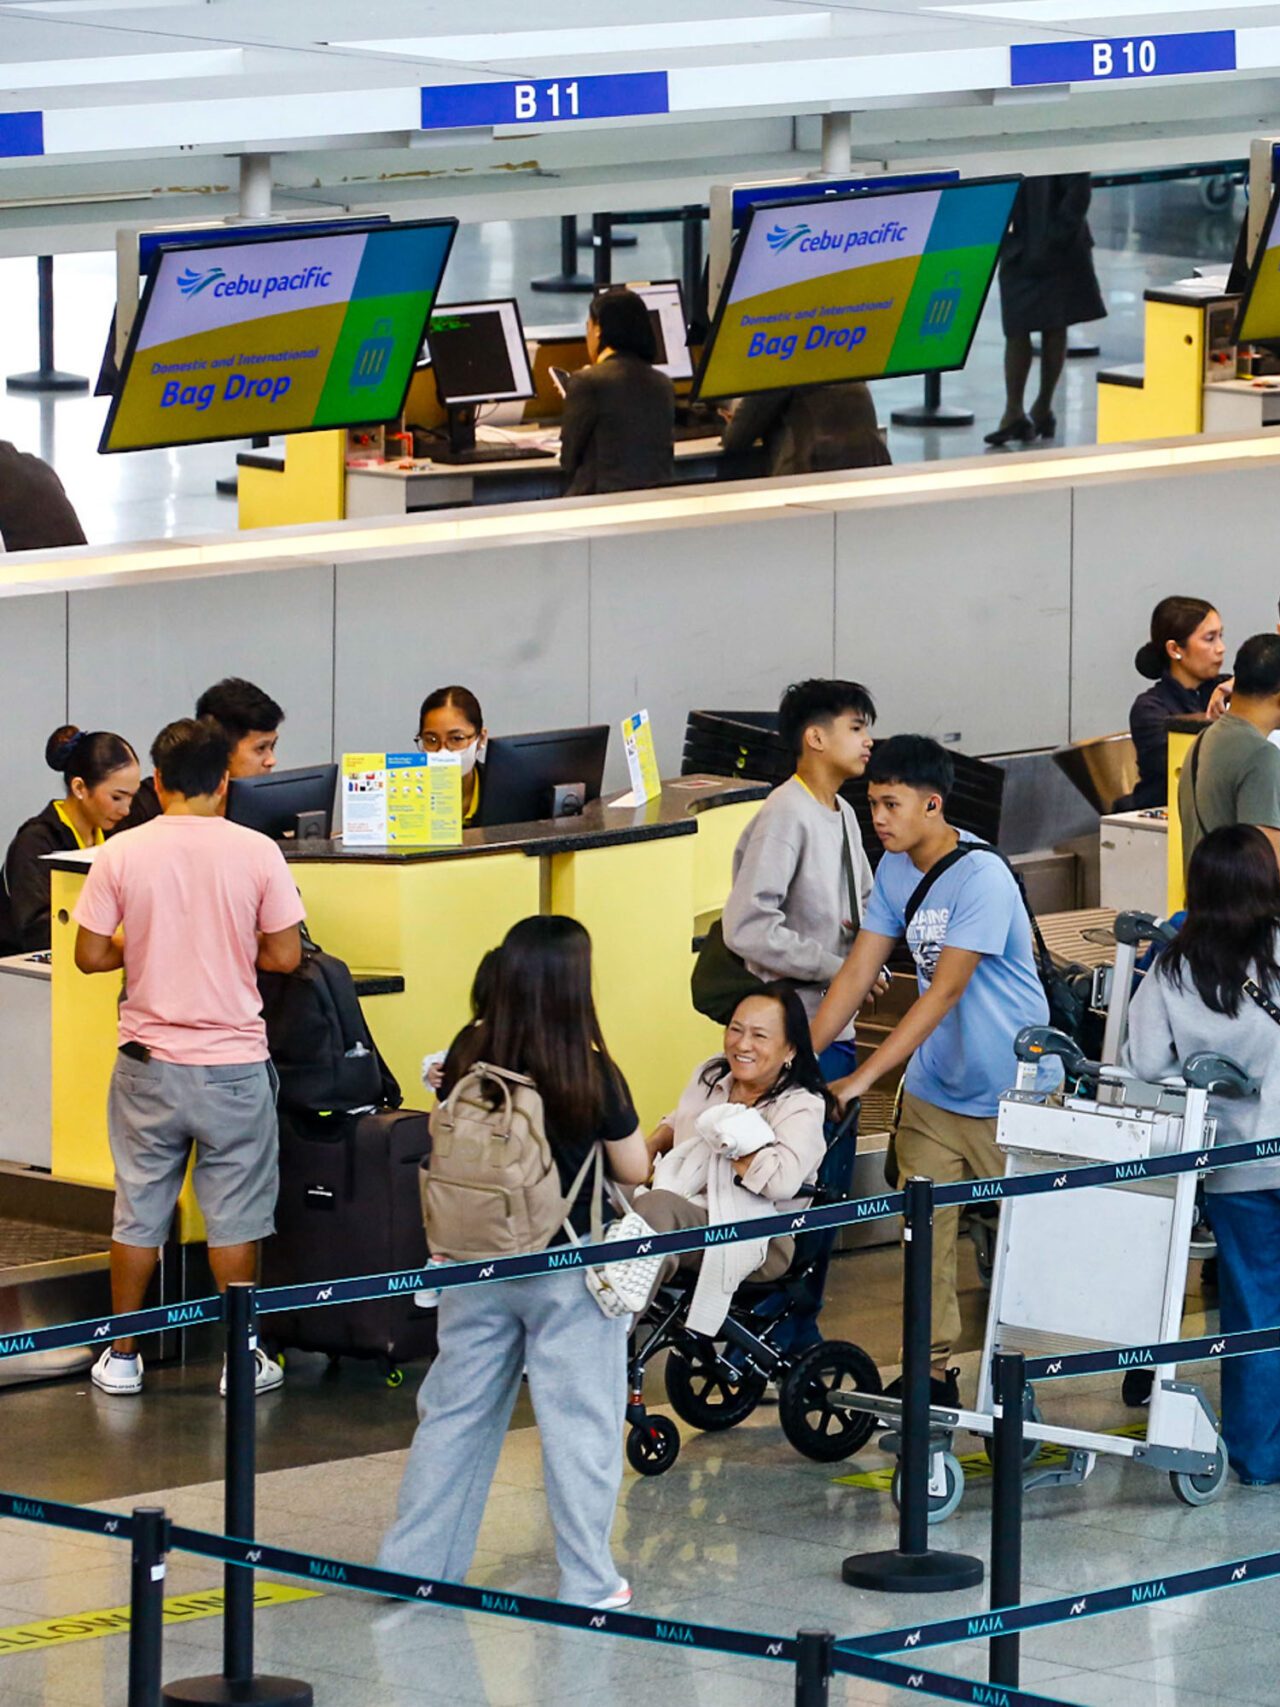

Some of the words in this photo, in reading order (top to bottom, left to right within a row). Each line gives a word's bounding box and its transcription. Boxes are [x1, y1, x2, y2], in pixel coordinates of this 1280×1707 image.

[1092, 43, 1113, 76] B
[1122, 40, 1156, 74] 10
[515, 84, 537, 119] B
[546, 82, 579, 117] 11
[800, 229, 842, 253] cebu
[844, 221, 908, 253] pacific
[214, 274, 260, 298] cebu
[263, 266, 333, 298] pacific
[741, 311, 791, 327] Domestic
[795, 307, 817, 320] and
[820, 297, 894, 318] International
[748, 331, 798, 361] Bag
[804, 324, 867, 352] Drop
[152, 358, 207, 375] Domestic
[212, 354, 234, 369] and
[240, 347, 319, 366] International
[160, 380, 216, 411] Bag
[223, 373, 292, 401] Drop
[1115, 1162, 1146, 1178] NAIA
[971, 1182, 1003, 1197] NAIA
[857, 1200, 890, 1217] NAIA
[705, 1226, 738, 1242] NAIA
[548, 1252, 583, 1268] NAIA
[388, 1275, 423, 1291] NAIA
[168, 1305, 204, 1323] NAIA
[1118, 1350, 1153, 1365] NAIA
[13, 1501, 45, 1517] NAIA
[310, 1561, 346, 1580] NAIA
[1132, 1582, 1166, 1602] NAIA
[481, 1593, 519, 1613] NAIA
[656, 1624, 693, 1642] NAIA
[968, 1616, 1003, 1635] NAIA
[973, 1687, 1009, 1706] NAIA
